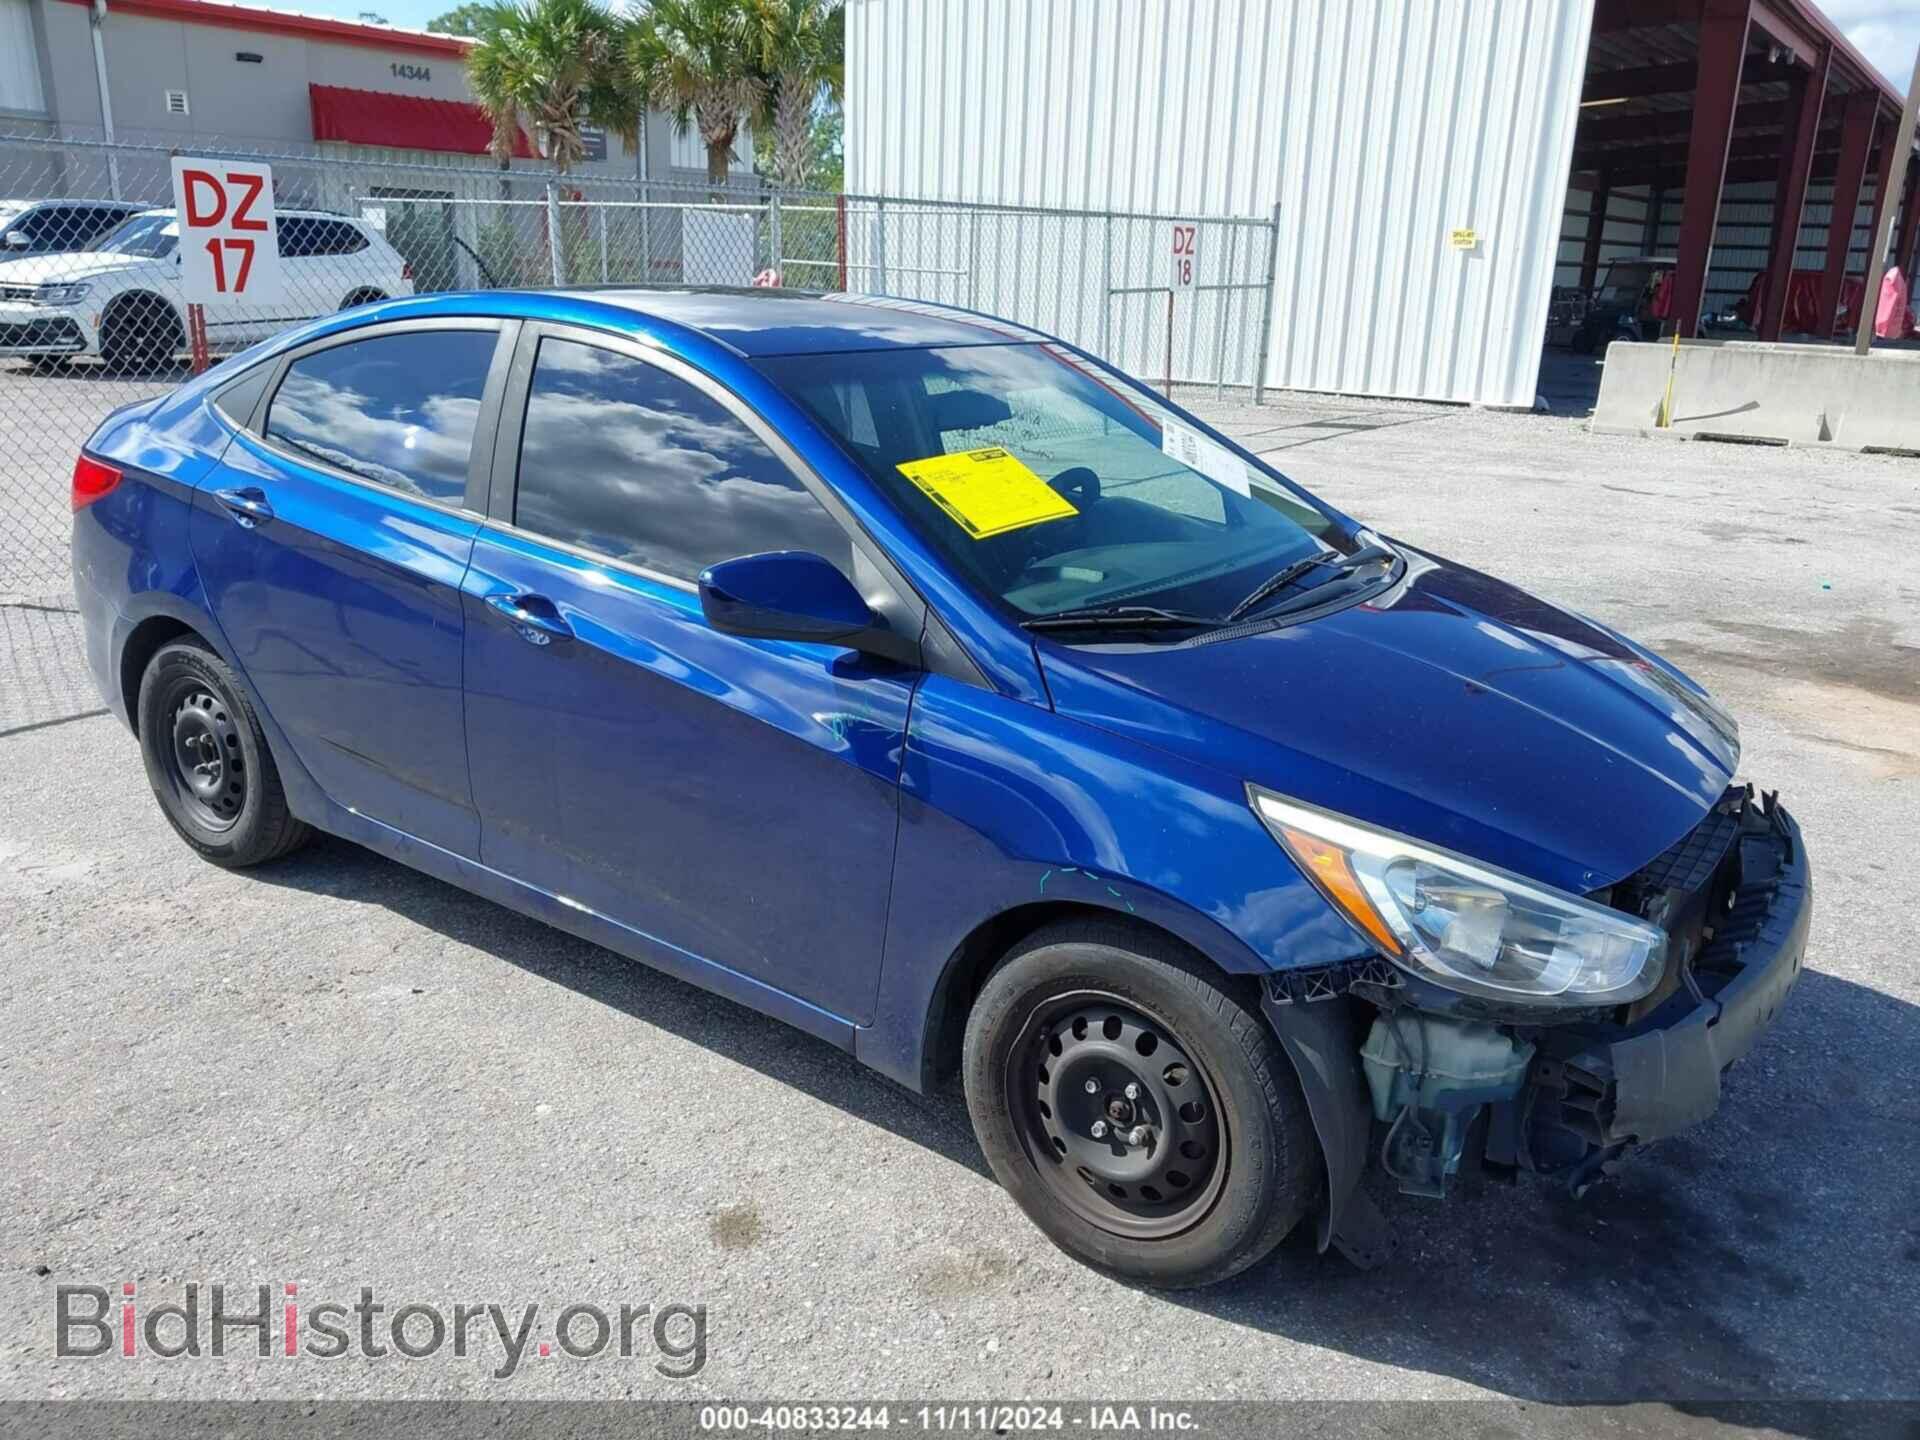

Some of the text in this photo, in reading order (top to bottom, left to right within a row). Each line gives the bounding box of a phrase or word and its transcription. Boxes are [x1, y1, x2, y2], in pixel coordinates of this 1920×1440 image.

[390, 63, 431, 81] 14344
[182, 169, 268, 231] DZ
[1173, 226, 1195, 255] DZ
[205, 238, 255, 292] 17
[1177, 259, 1192, 286] 18
